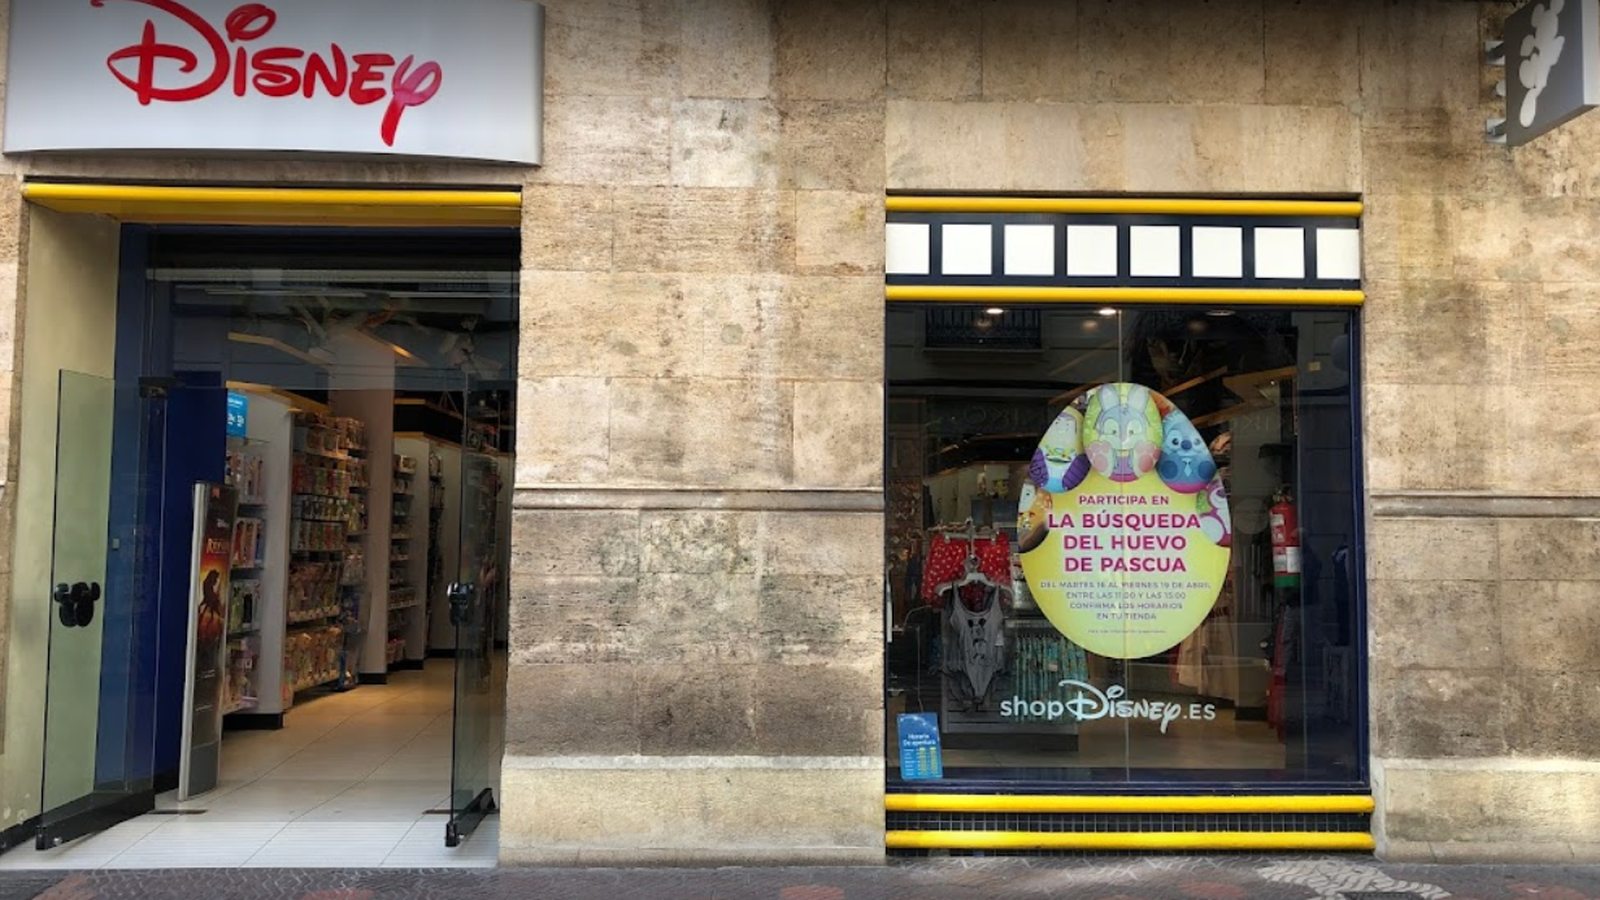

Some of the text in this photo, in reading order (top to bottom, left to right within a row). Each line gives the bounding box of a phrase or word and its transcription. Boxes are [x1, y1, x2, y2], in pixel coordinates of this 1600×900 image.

[1079, 495, 1169, 506] PARTICIPA EN
[1048, 509, 1201, 531] LA BÚSQUEDA
[1063, 535, 1187, 550] DEL HUEVO
[1064, 557, 1187, 572] DE PASCUA
[1040, 581, 1057, 589] DEL
[1059, 581, 1095, 589] MARTES
[1108, 581, 1119, 589] AL
[1121, 581, 1159, 589] VIERNES
[1160, 581, 1170, 589] 19
[1172, 581, 1183, 589] DE
[1186, 581, 1211, 589] ABRIL
[1066, 591, 1095, 600] ENTRE
[1099, 591, 1113, 600] LAS
[1137, 591, 1144, 600] Y
[1146, 591, 1162, 600] LAS
[1069, 602, 1183, 610] CONFIRMA LOS HORARIOS
[1096, 612, 1157, 620] EN TU TIENDA
